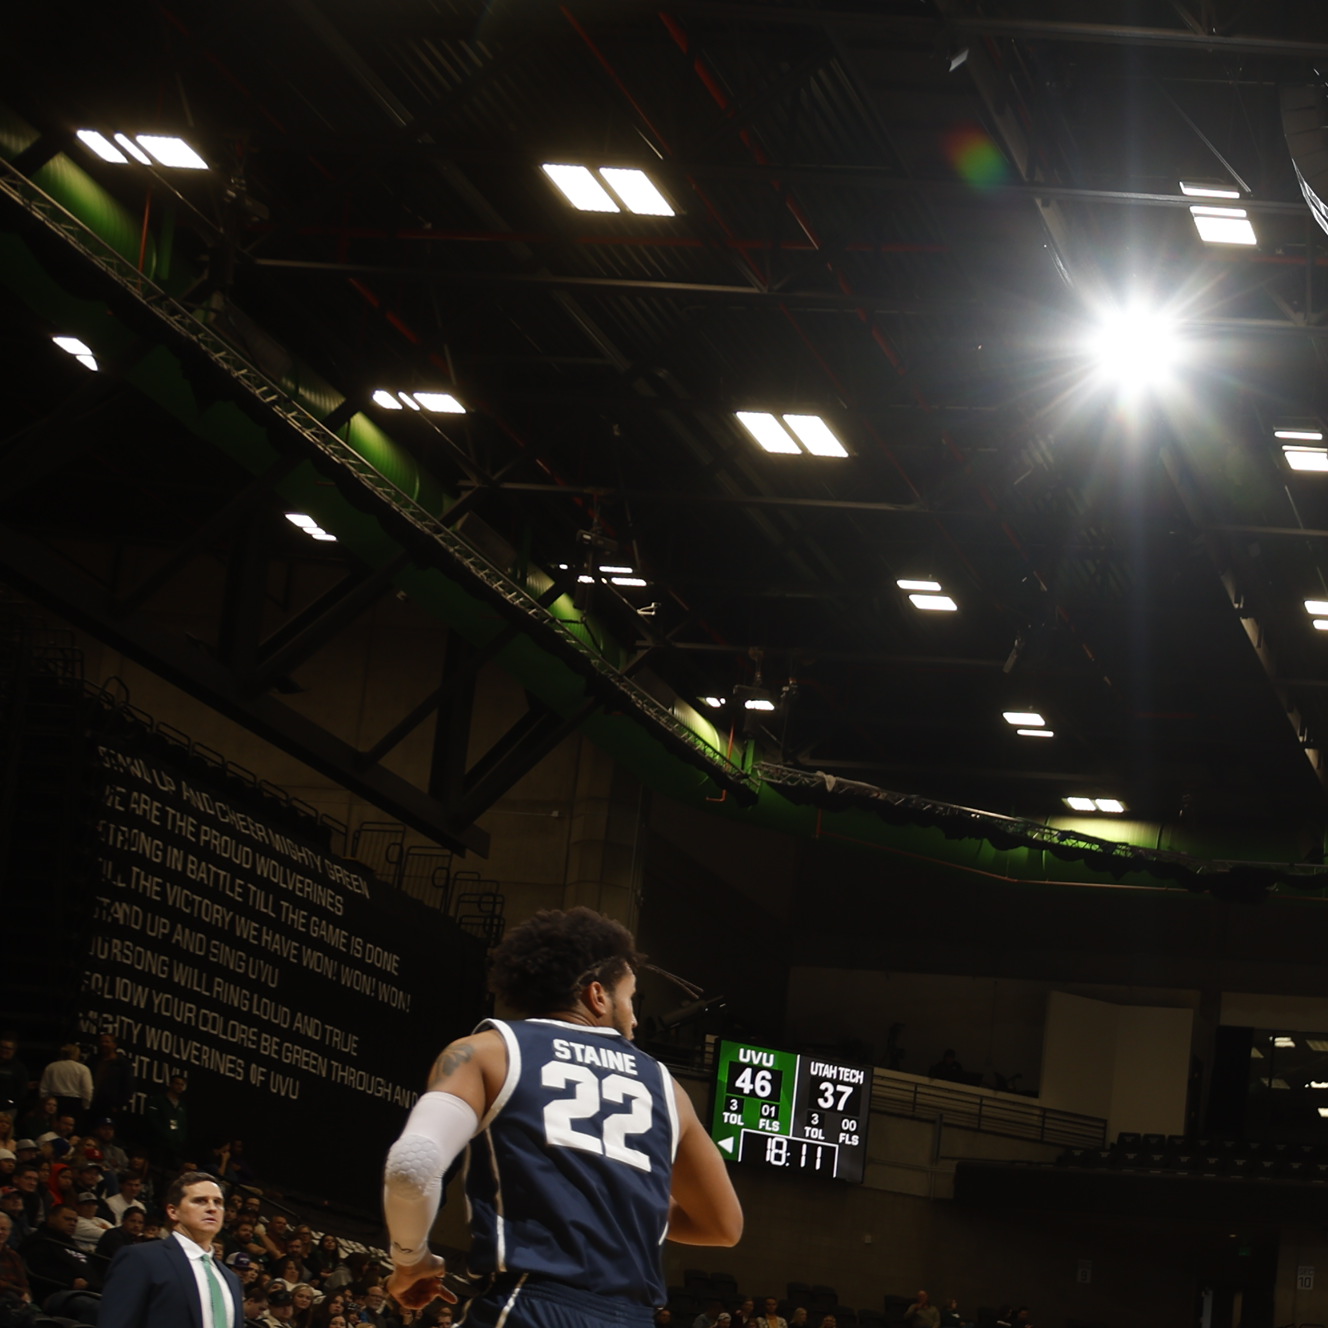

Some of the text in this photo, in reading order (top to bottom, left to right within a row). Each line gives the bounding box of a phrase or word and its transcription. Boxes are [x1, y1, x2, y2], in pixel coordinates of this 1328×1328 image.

[129, 792, 344, 916] ARE THE PROUD WOLVERINES
[181, 780, 370, 899] AND CHEER MIGHTY GREEN
[166, 845, 400, 976] IN BATTLE TILL THE GAME IS DONE
[131, 866, 411, 1013] THE VICTORY WE HAVE WON! WON! WON!
[146, 913, 279, 988] UP AND SING UVU
[152, 989, 197, 1026] YOUR
[260, 1033, 280, 1059] BE
[282, 1042, 328, 1078] GREEN
[330, 1060, 392, 1101] THROUGH
[252, 994, 290, 1028] LOUD
[293, 1012, 322, 1040] AND
[324, 1024, 359, 1056] TRUE
[145, 1025, 245, 1081] WOLVERINES
[250, 1062, 267, 1087] OF
[270, 1071, 299, 1100] UVU
[553, 1039, 638, 1076] STAINE
[739, 1048, 774, 1067] UVU
[810, 1062, 864, 1084] UTAH TECH
[735, 1067, 772, 1098] 46
[817, 1082, 853, 1111] 37
[541, 1060, 652, 1172] 22
[723, 1112, 780, 1132] TOL FLS
[730, 1099, 775, 1117] 3 01
[811, 1114, 857, 1131] 3 00
[804, 1126, 859, 1146] TOL FLS
